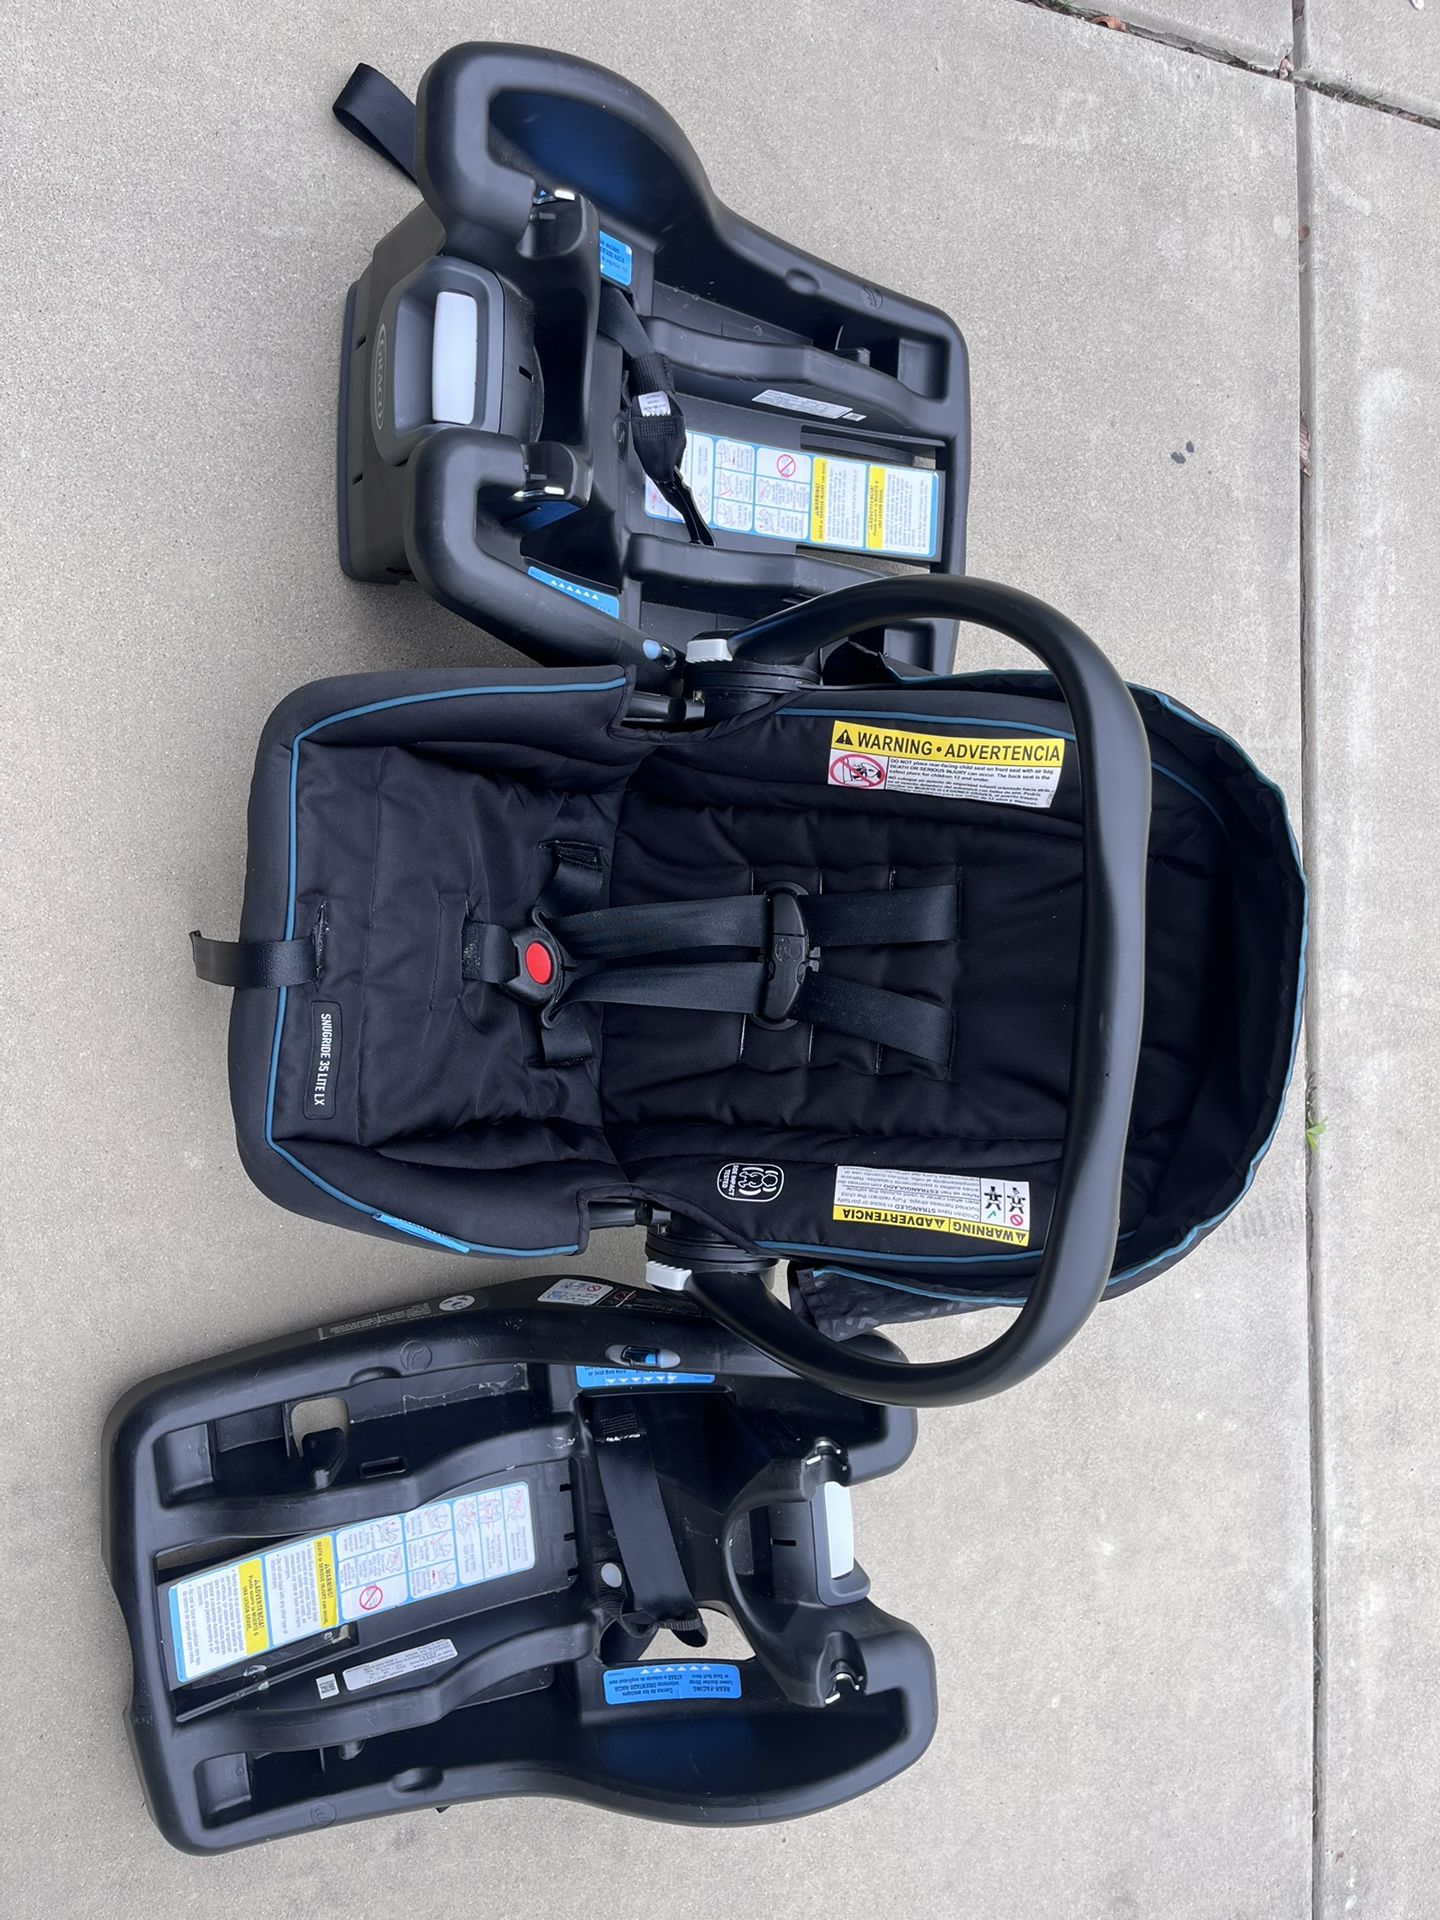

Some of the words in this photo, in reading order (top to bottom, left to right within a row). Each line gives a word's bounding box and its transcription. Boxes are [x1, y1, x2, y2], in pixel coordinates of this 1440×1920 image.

[857, 731, 932, 756] WARNING
[944, 743, 1060, 762] ADVERTENCIA
[320, 1013, 333, 1059] SNUGRIDE
[319, 1060, 330, 1072] 35
[314, 1072, 328, 1092] LITE
[314, 1093, 325, 1106] LX
[722, 1169, 731, 1188] TESTED
[728, 1175, 737, 1196] IMPACT
[883, 1184, 938, 1194] ESTRANGULADO
[894, 1203, 936, 1213] STRANGLED
[843, 1208, 934, 1228] ADVERTENCIA
[953, 1221, 1014, 1242] WARNING
[692, 1685, 730, 1693] REAR-FACING
